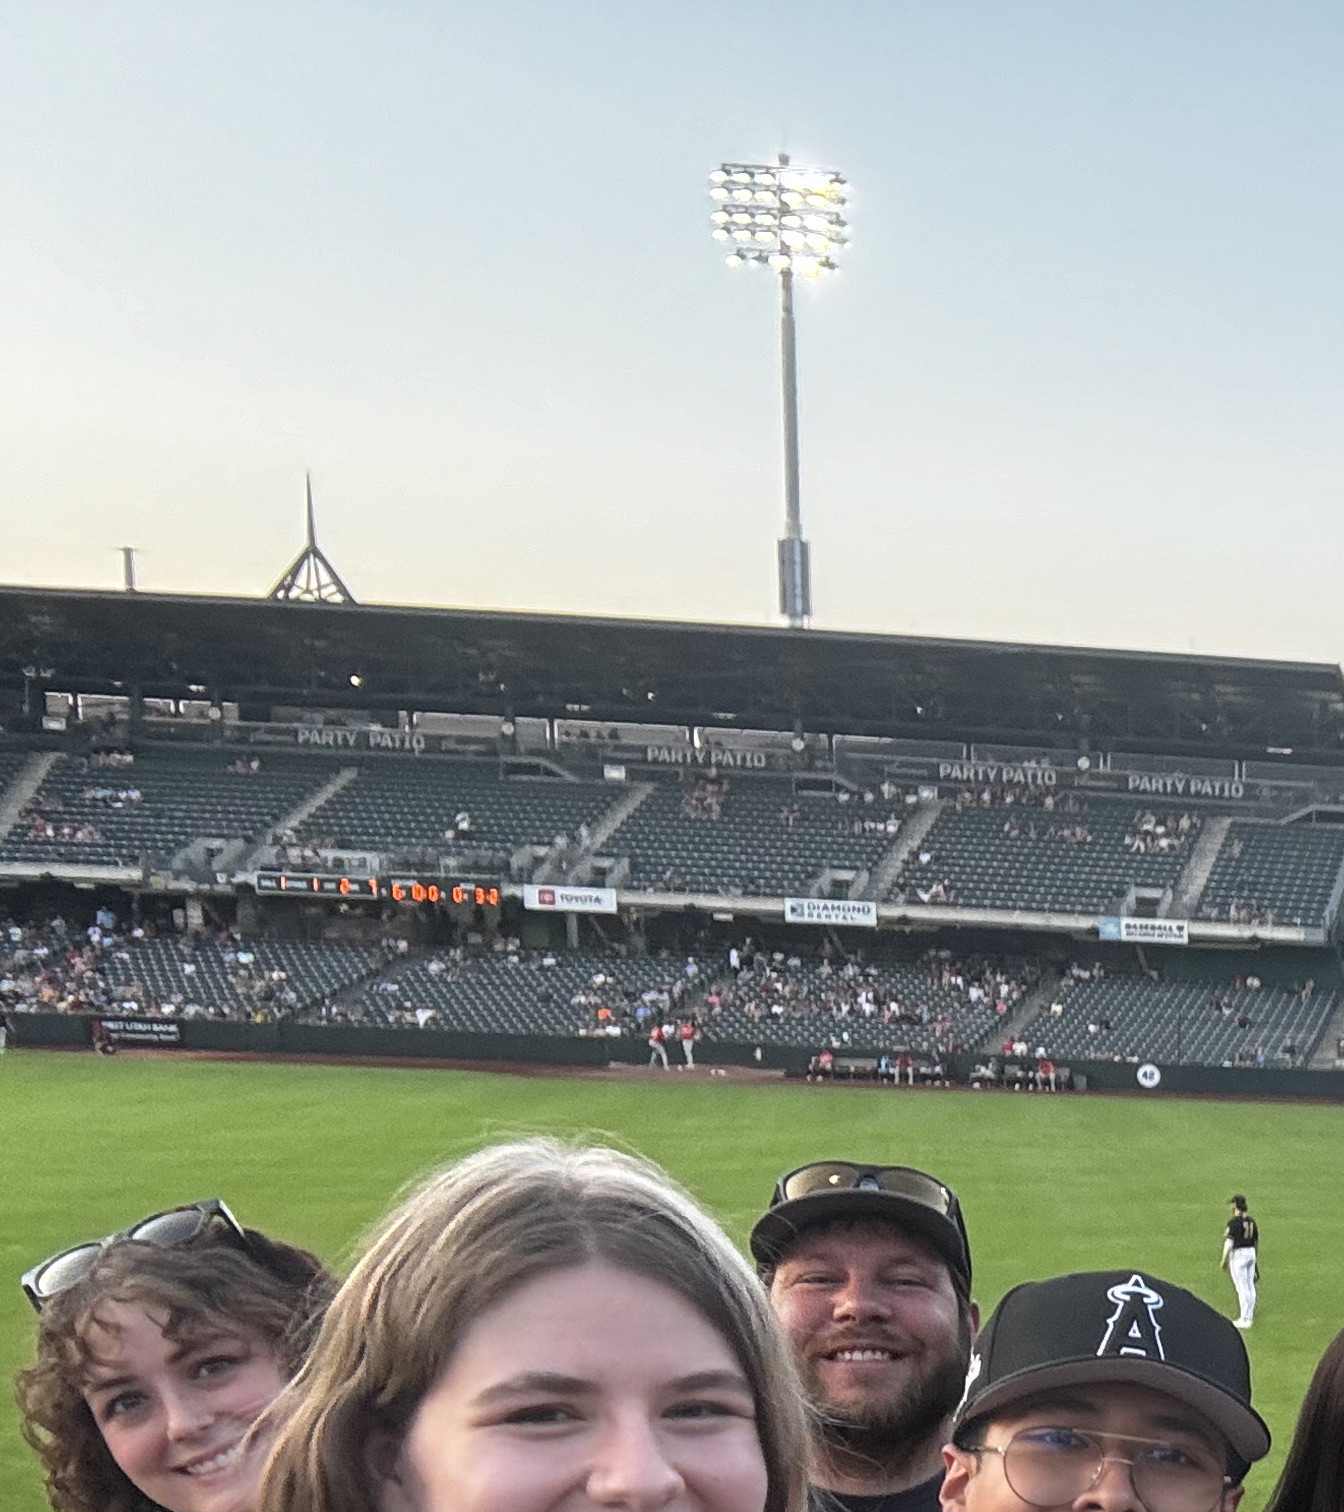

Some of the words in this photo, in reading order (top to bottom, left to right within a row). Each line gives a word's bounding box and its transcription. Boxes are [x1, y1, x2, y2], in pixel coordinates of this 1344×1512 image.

[297, 729, 356, 747] PARTY
[368, 730, 425, 750] PATIO
[646, 745, 706, 764] PARTY
[710, 748, 766, 768] PATIO
[939, 762, 998, 782] PARTY
[1002, 766, 1057, 786] PATIO
[1127, 775, 1186, 794] PARTY
[1189, 778, 1244, 798] PATIO
[1096, 1274, 1166, 1361] A
